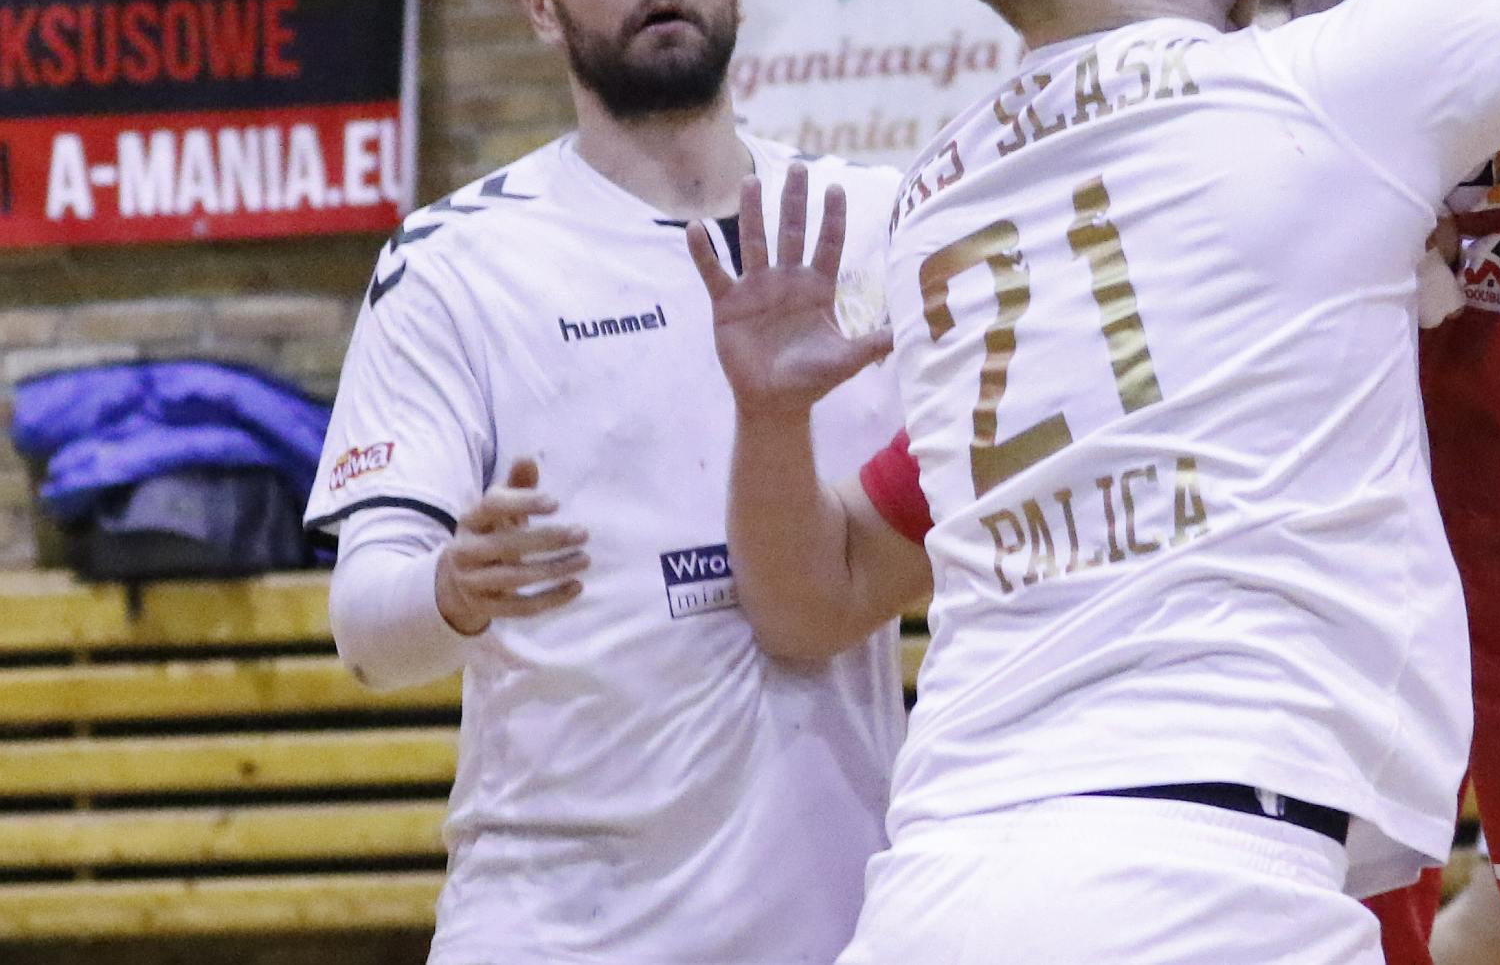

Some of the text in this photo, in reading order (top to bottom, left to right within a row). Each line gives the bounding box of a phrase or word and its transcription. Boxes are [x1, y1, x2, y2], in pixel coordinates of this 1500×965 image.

[730, 31, 1000, 101] ganizacja
[558, 304, 667, 342] hummel
[918, 175, 1163, 500] 21
[979, 457, 1209, 594] PALICA
[667, 551, 732, 581] Wro
